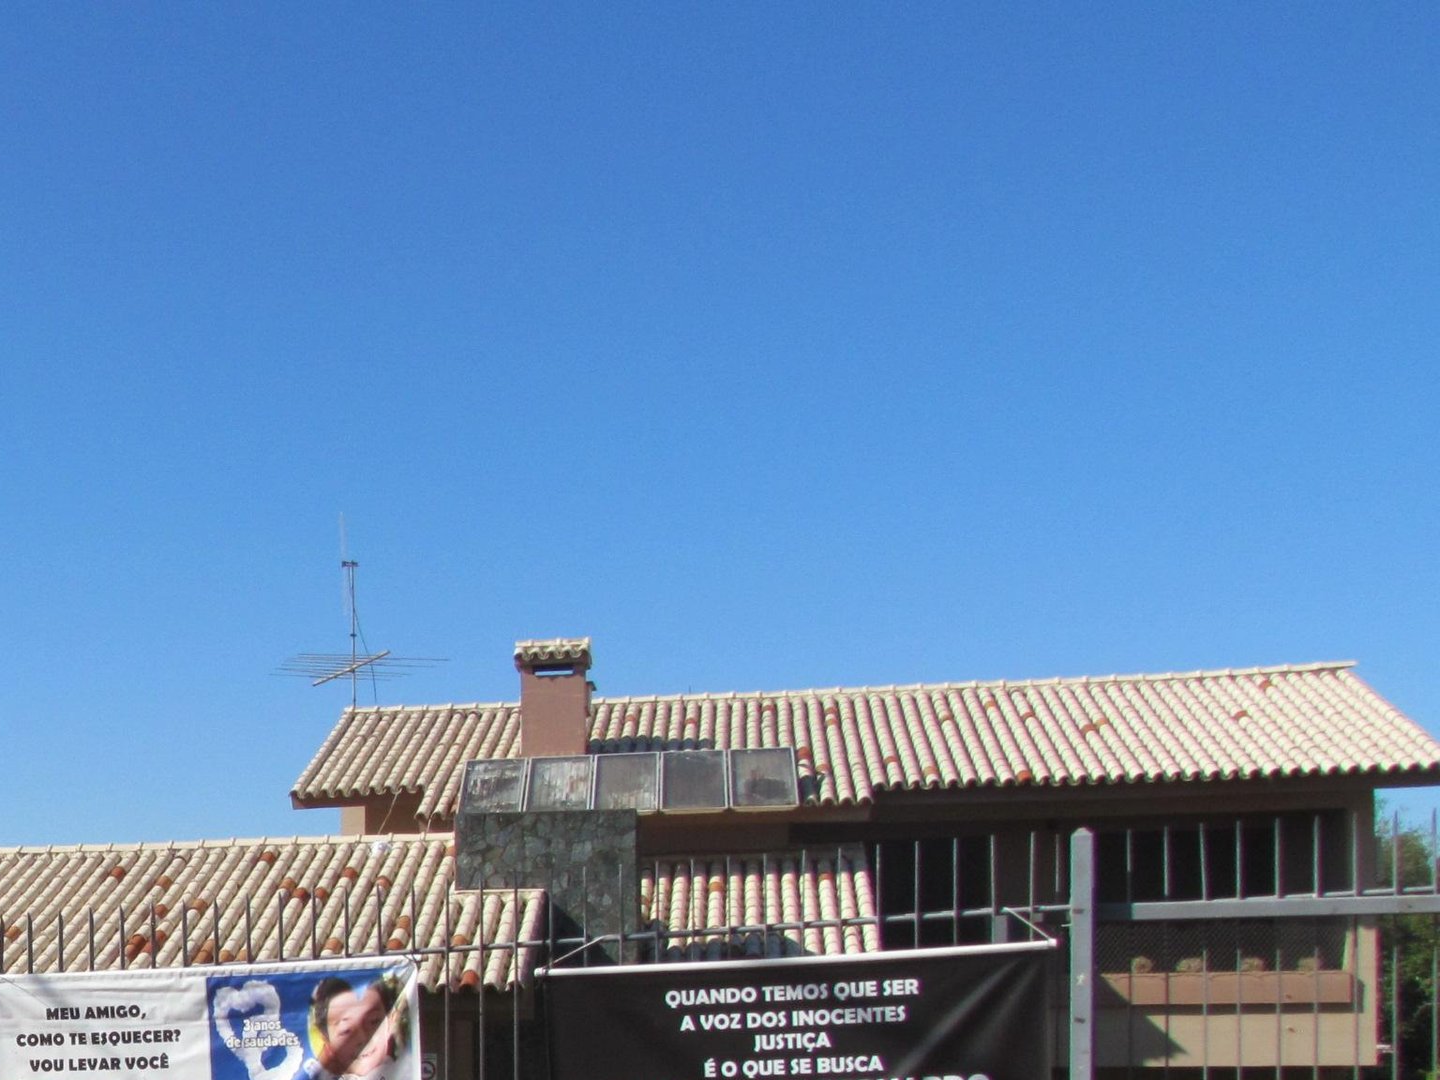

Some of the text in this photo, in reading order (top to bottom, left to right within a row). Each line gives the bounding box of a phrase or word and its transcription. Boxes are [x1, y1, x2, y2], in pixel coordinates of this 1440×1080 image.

[665, 978, 919, 1008] QUANDO TEMOS QUE SER
[46, 1005, 146, 1020] MEU AMIGO,
[680, 1006, 906, 1032] A VOZ DOS INOCENTES
[243, 1019, 281, 1031] 3 anos
[16, 1029, 181, 1047] COMO TE ESQUECER?
[226, 1034, 300, 1048] de saudades
[753, 1032, 832, 1052] JUSTIÇA
[30, 1053, 169, 1072] VOU LEVAR VOCÊ
[704, 1055, 884, 1079] É O QUE SE BUSCA
